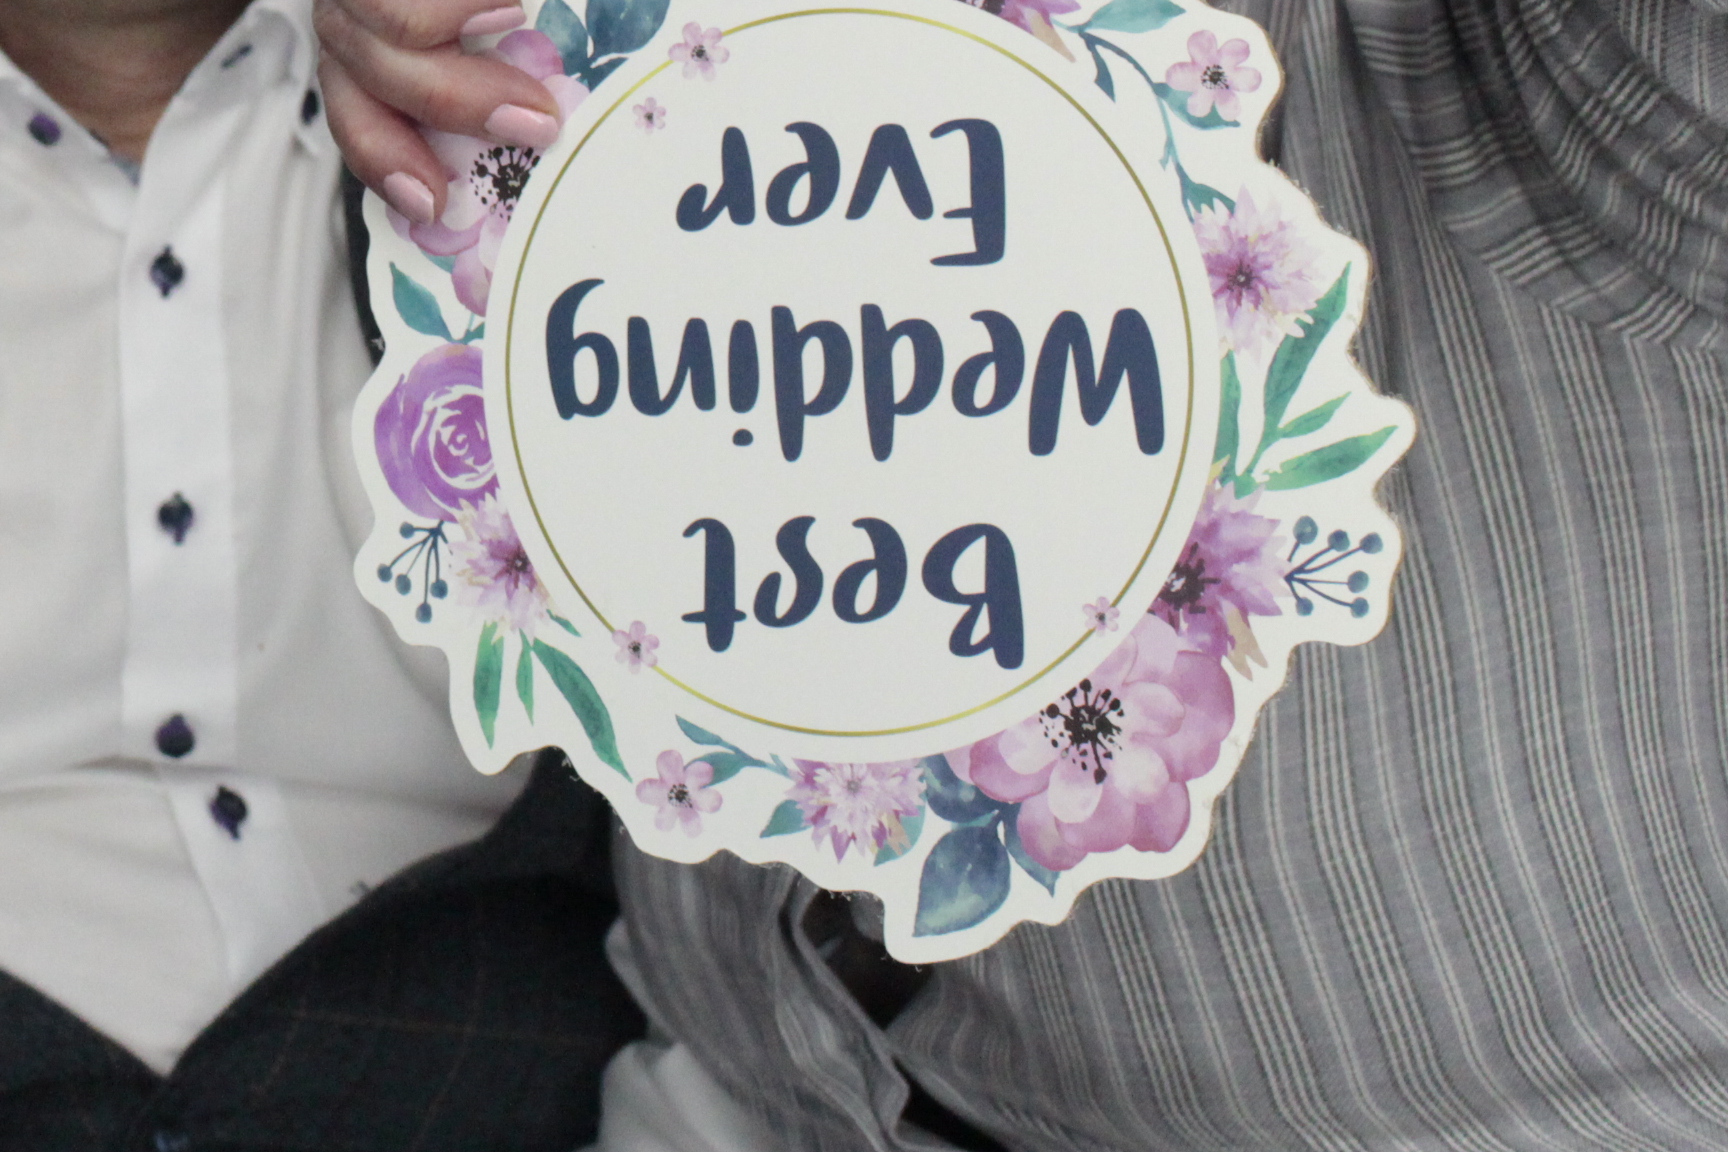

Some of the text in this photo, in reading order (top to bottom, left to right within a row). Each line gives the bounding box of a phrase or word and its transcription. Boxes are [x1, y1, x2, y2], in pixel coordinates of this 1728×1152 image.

[675, 118, 1006, 267] Ever
[545, 278, 1165, 462] Wedding
[681, 515, 1024, 670] Best
